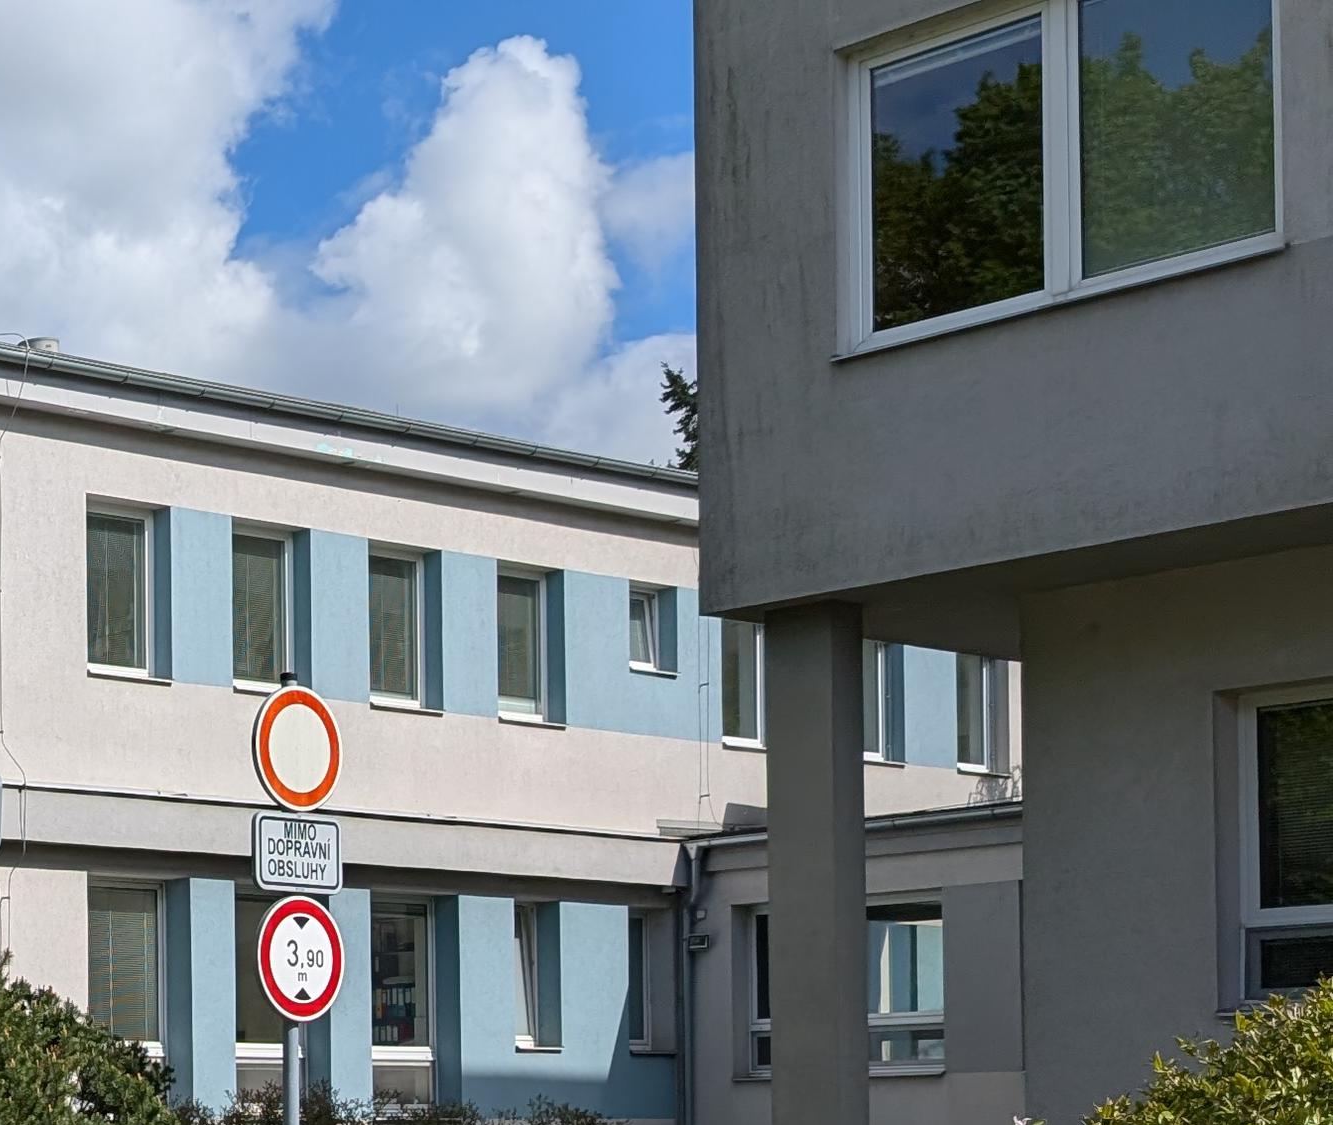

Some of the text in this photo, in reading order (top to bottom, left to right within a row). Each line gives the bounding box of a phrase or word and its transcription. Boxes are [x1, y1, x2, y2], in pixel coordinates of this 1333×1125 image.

[284, 822, 317, 840] MIMO
[268, 838, 331, 860] DOPRAVNÍ
[268, 859, 327, 881] OBSLUHY
[287, 939, 324, 970] 3,90
[298, 971, 308, 982] m
